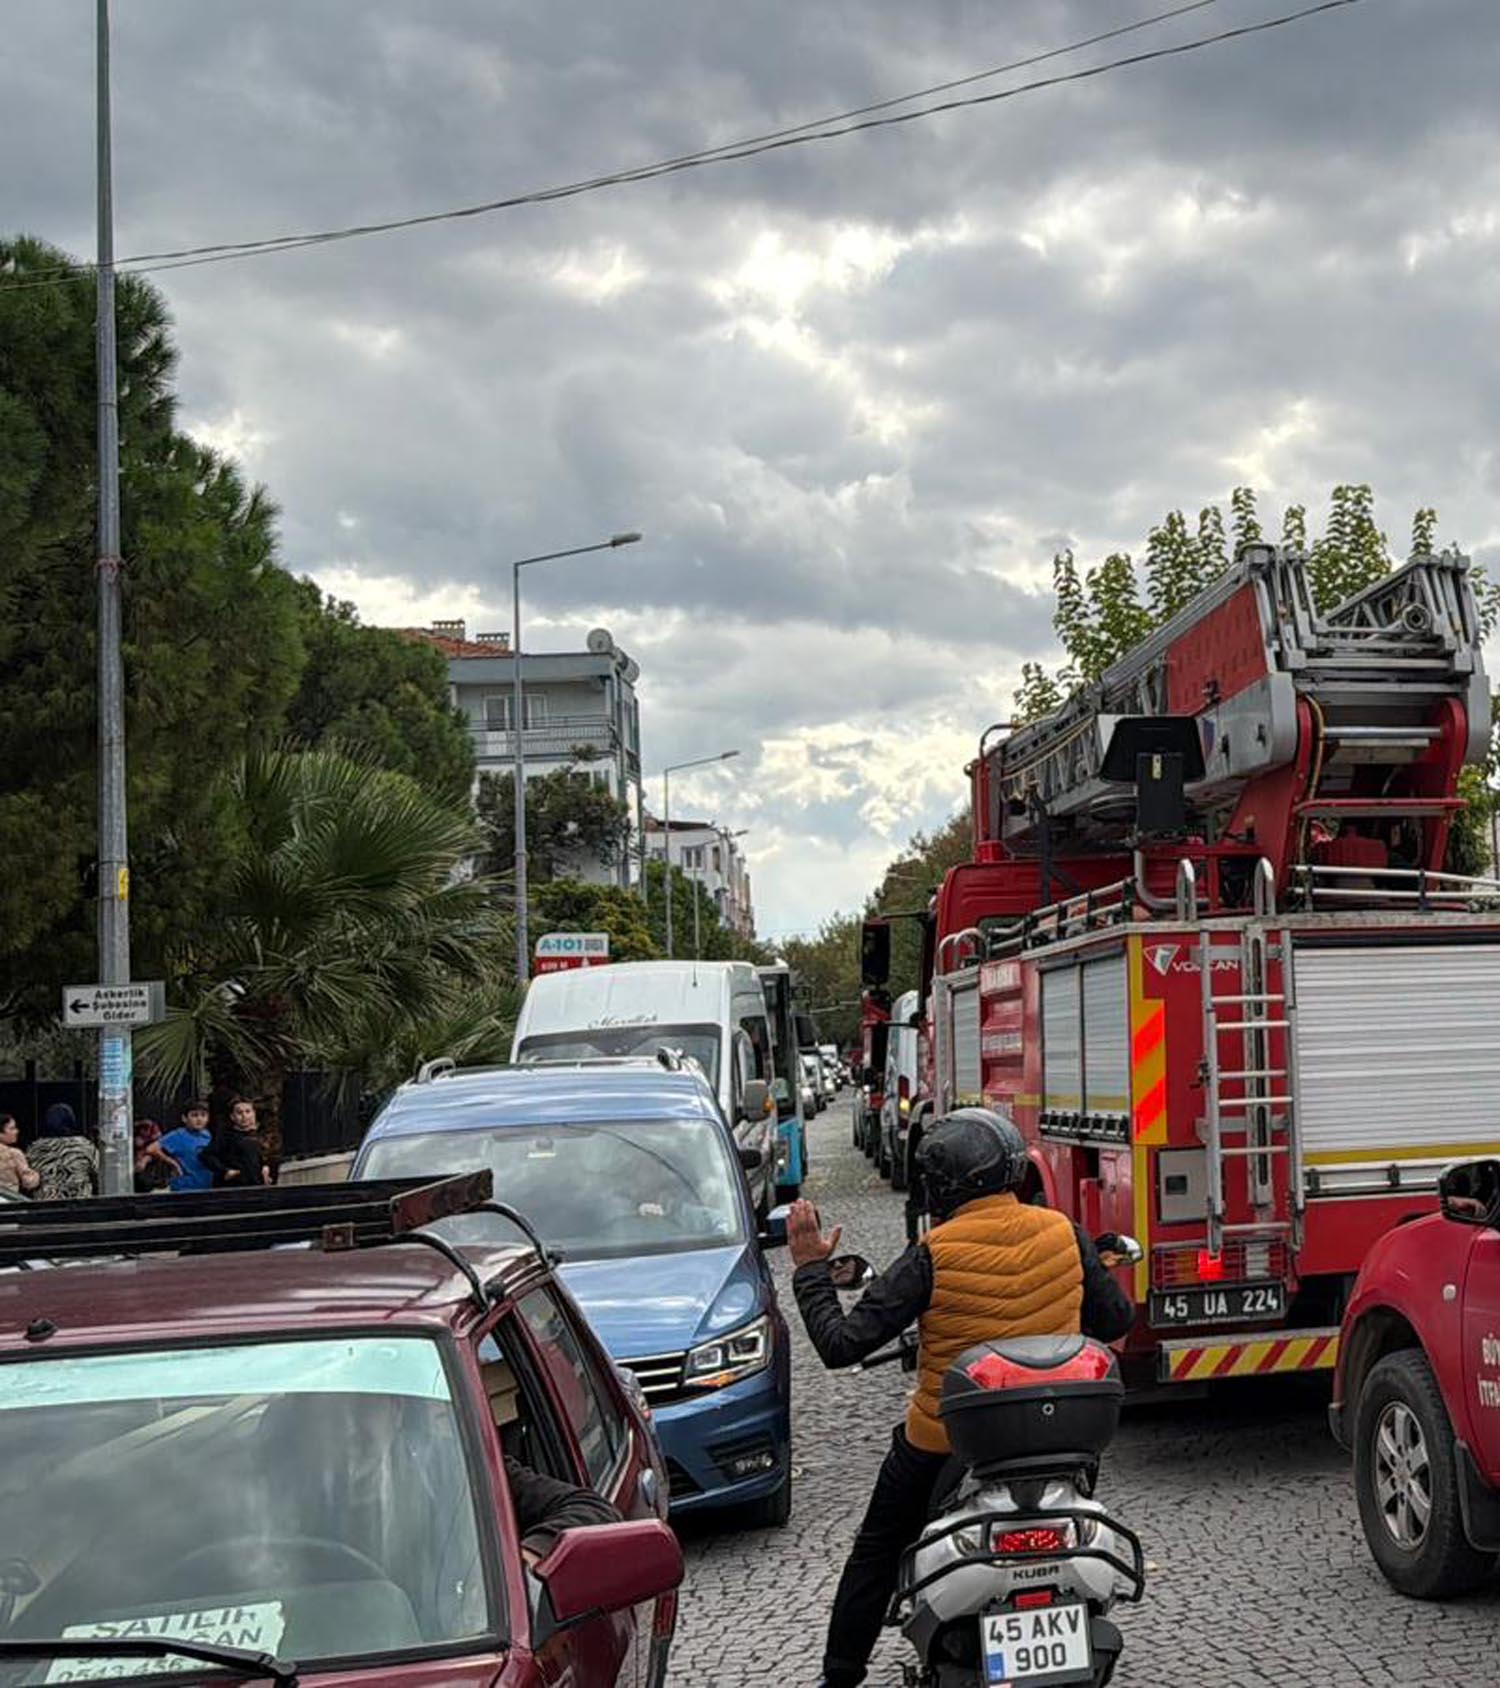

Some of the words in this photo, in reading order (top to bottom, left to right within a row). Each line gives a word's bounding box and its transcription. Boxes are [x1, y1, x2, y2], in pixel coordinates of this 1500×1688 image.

[95, 989, 143, 999] Askerlik
[93, 1000, 147, 1012] Şubesine
[103, 1011, 136, 1021] Gider
[1164, 1296, 1188, 1318] 45
[1204, 1292, 1228, 1315] UA
[1242, 1288, 1278, 1312] 224
[1013, 1565, 1059, 1580] KUBA
[990, 1618, 1022, 1644] 45
[1032, 1609, 1079, 1639] AKV
[1016, 1642, 1067, 1672] 900
